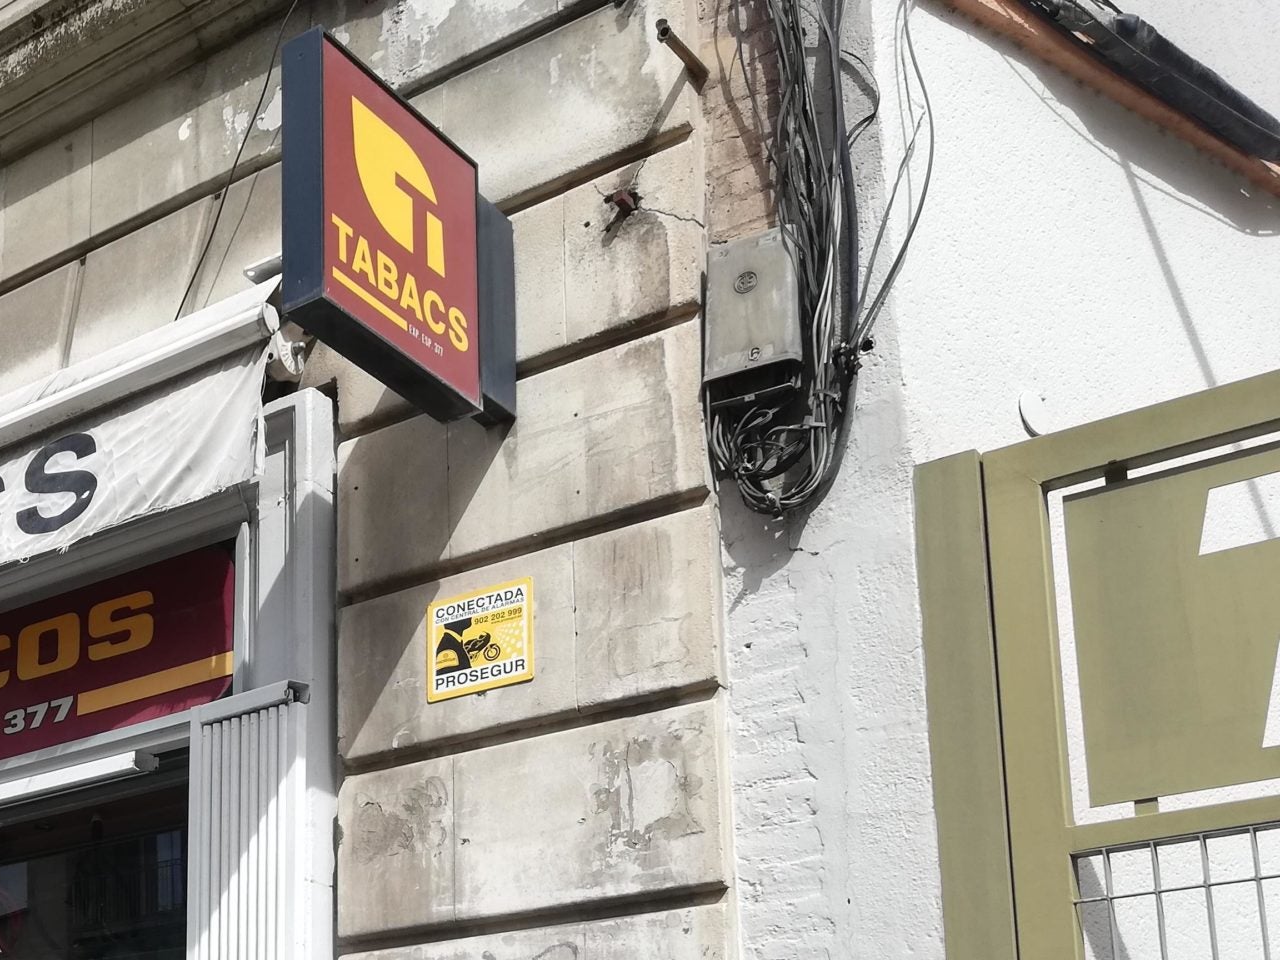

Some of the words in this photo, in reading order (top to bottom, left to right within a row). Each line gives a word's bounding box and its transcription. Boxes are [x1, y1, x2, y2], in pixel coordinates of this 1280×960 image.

[332, 213, 469, 353] TABACS
[436, 587, 524, 619] CONECTADA
[451, 610, 480, 621] CENTRAL
[491, 597, 525, 610] ALARMAS
[474, 615, 489, 625] 902
[491, 611, 506, 621] 202
[508, 607, 523, 617] 999
[436, 658, 525, 690] PROSEGUR
[3, 695, 74, 735] 377
